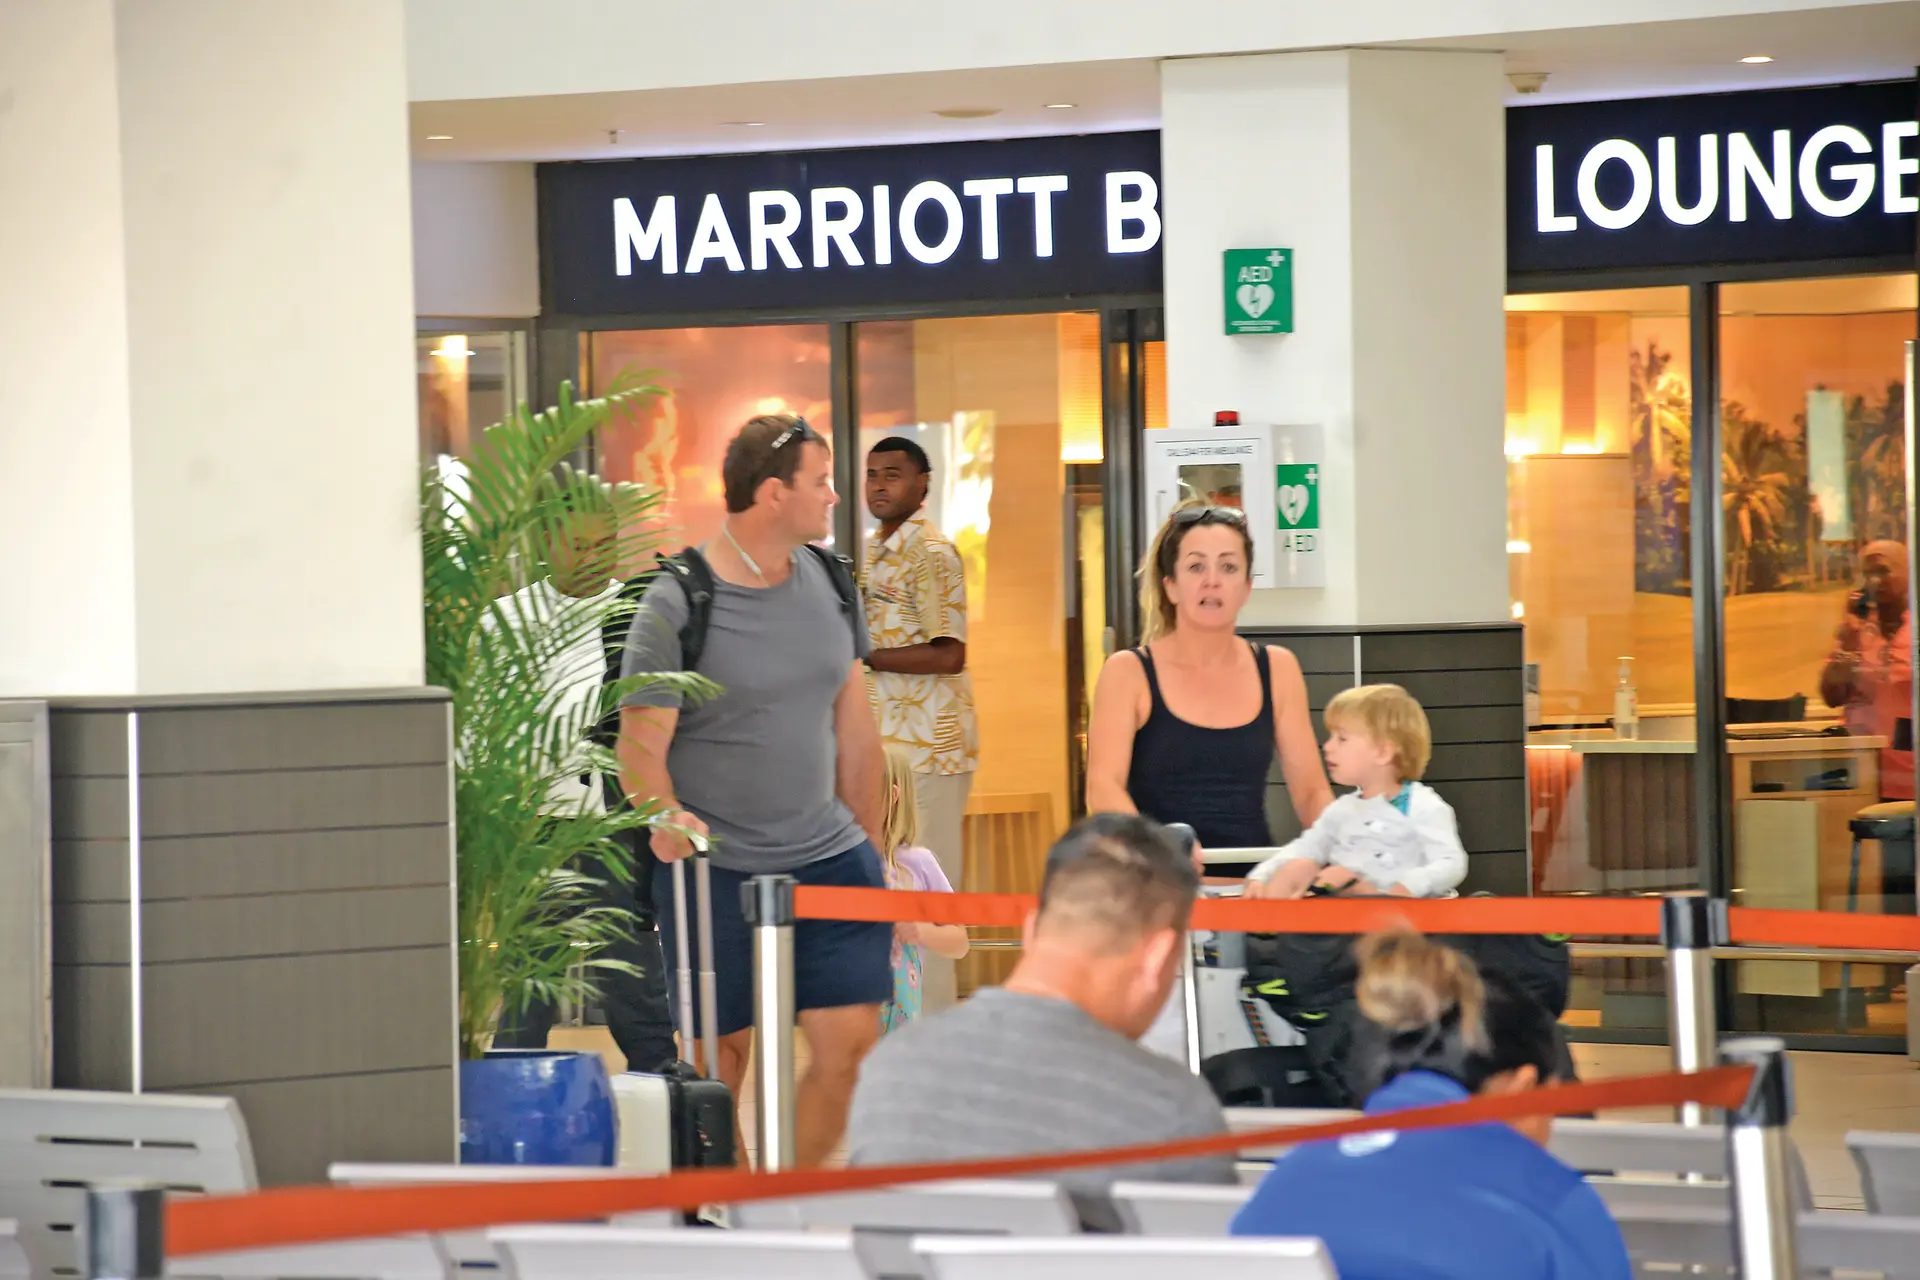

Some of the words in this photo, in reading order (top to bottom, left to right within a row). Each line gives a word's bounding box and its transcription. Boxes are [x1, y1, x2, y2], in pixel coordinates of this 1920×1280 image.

[612, 174, 1069, 276] MARRIOTT
[1535, 120, 1919, 233] LOUNGE
[1237, 265, 1273, 283] AED
[1282, 534, 1317, 553] AED
